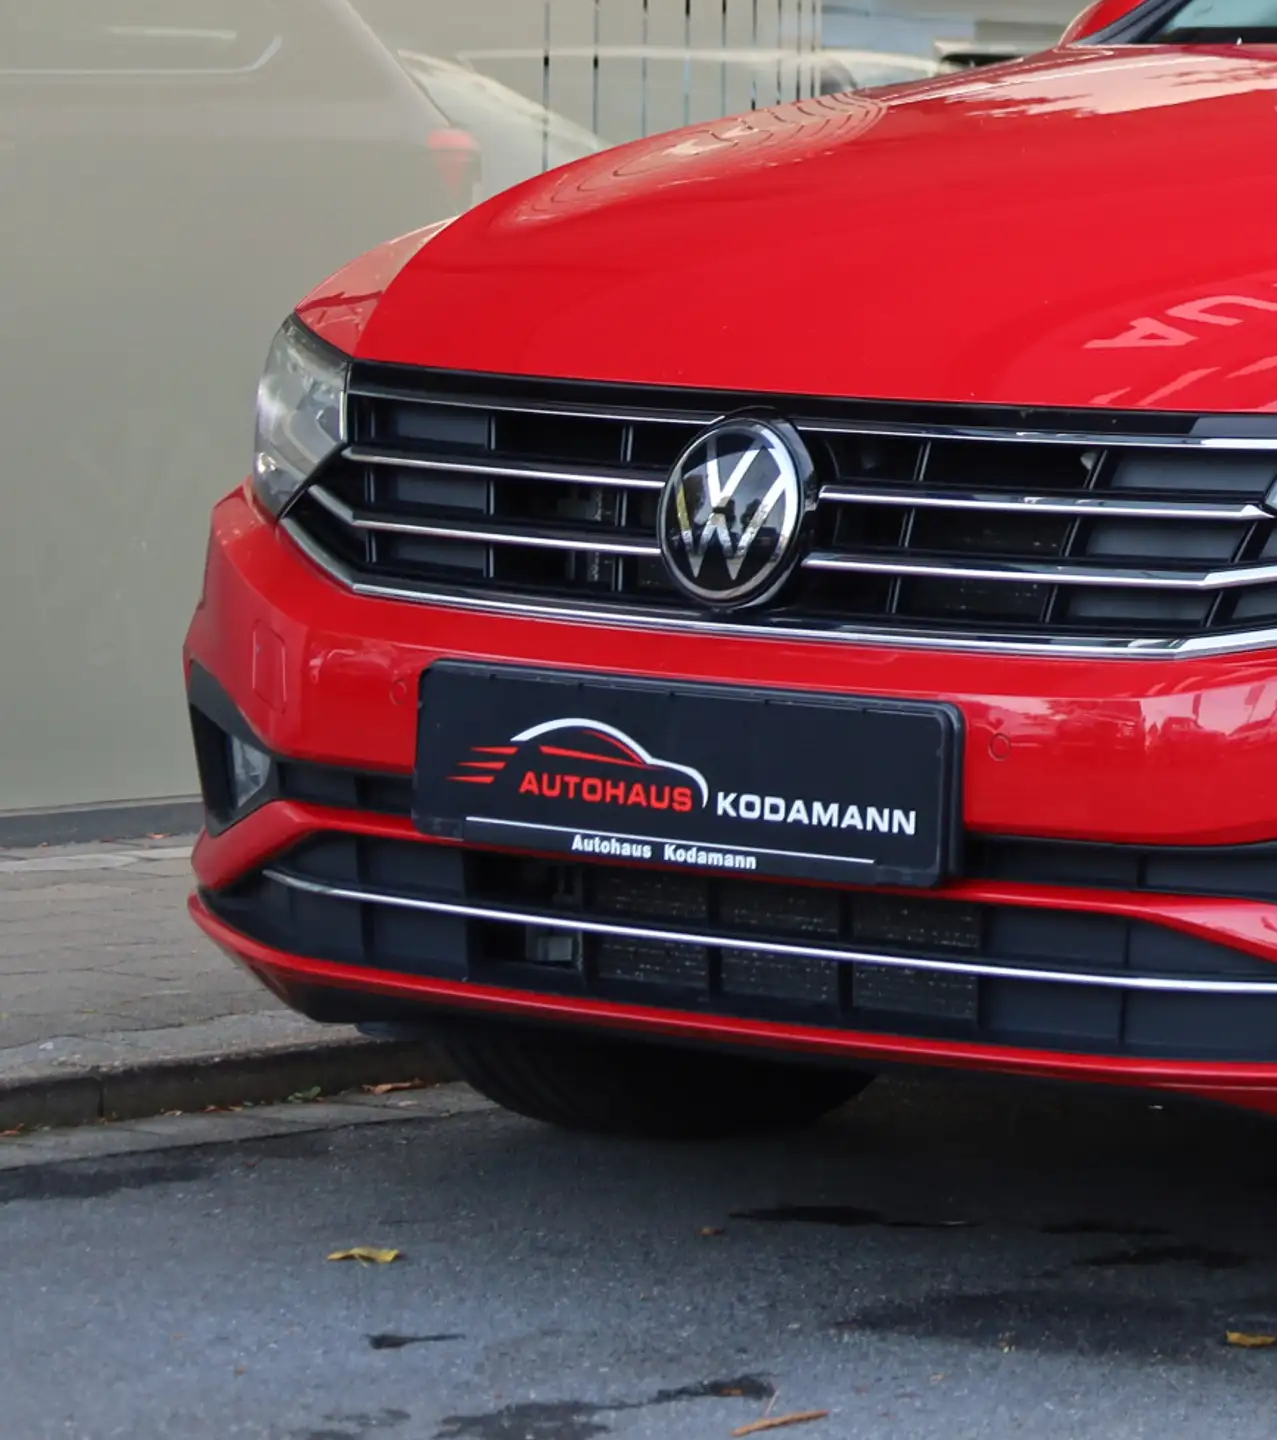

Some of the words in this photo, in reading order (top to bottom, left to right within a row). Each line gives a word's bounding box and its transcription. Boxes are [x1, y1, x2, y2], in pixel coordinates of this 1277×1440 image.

[518, 770, 692, 813] AUTOHAUS
[716, 791, 916, 835] KODAMANN
[572, 834, 652, 859] Autohaus
[664, 843, 757, 870] Kodamann
